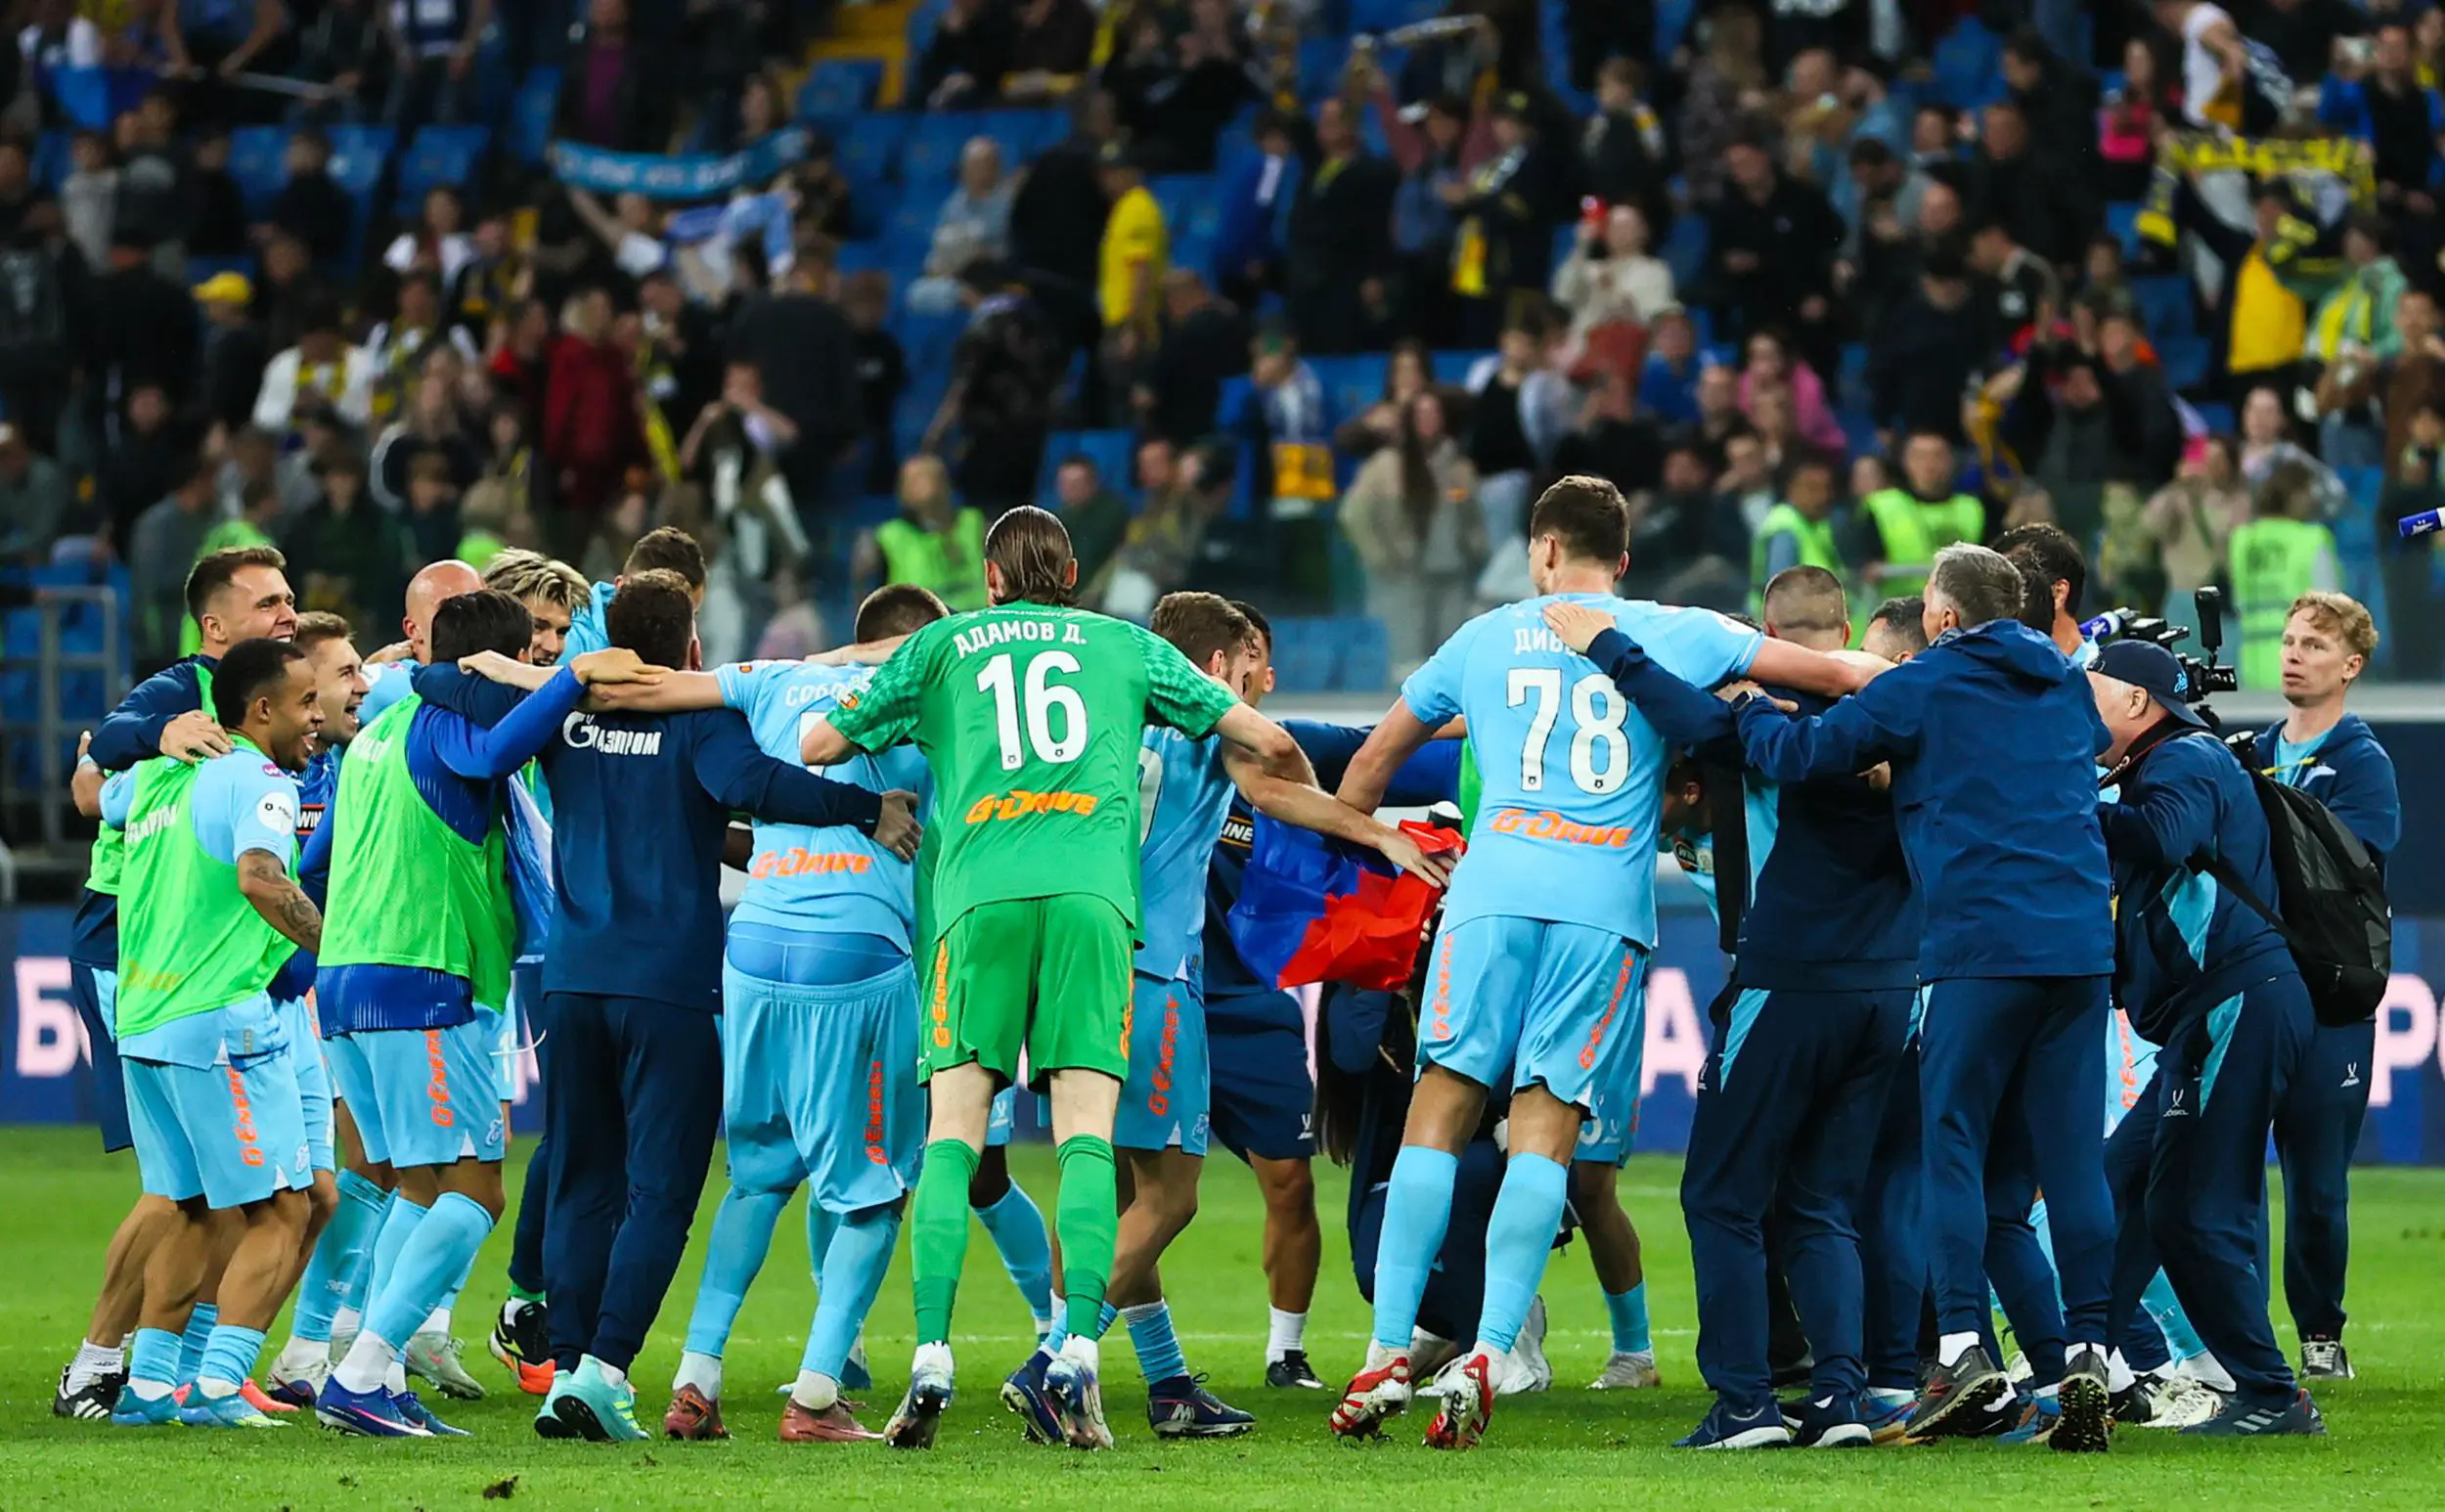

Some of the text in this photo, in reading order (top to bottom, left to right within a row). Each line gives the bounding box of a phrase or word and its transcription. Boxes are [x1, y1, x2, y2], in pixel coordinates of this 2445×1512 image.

[953, 619, 1088, 659] АДАМОВ Д.
[976, 649, 1089, 771] 16
[1507, 667, 1630, 794] 78
